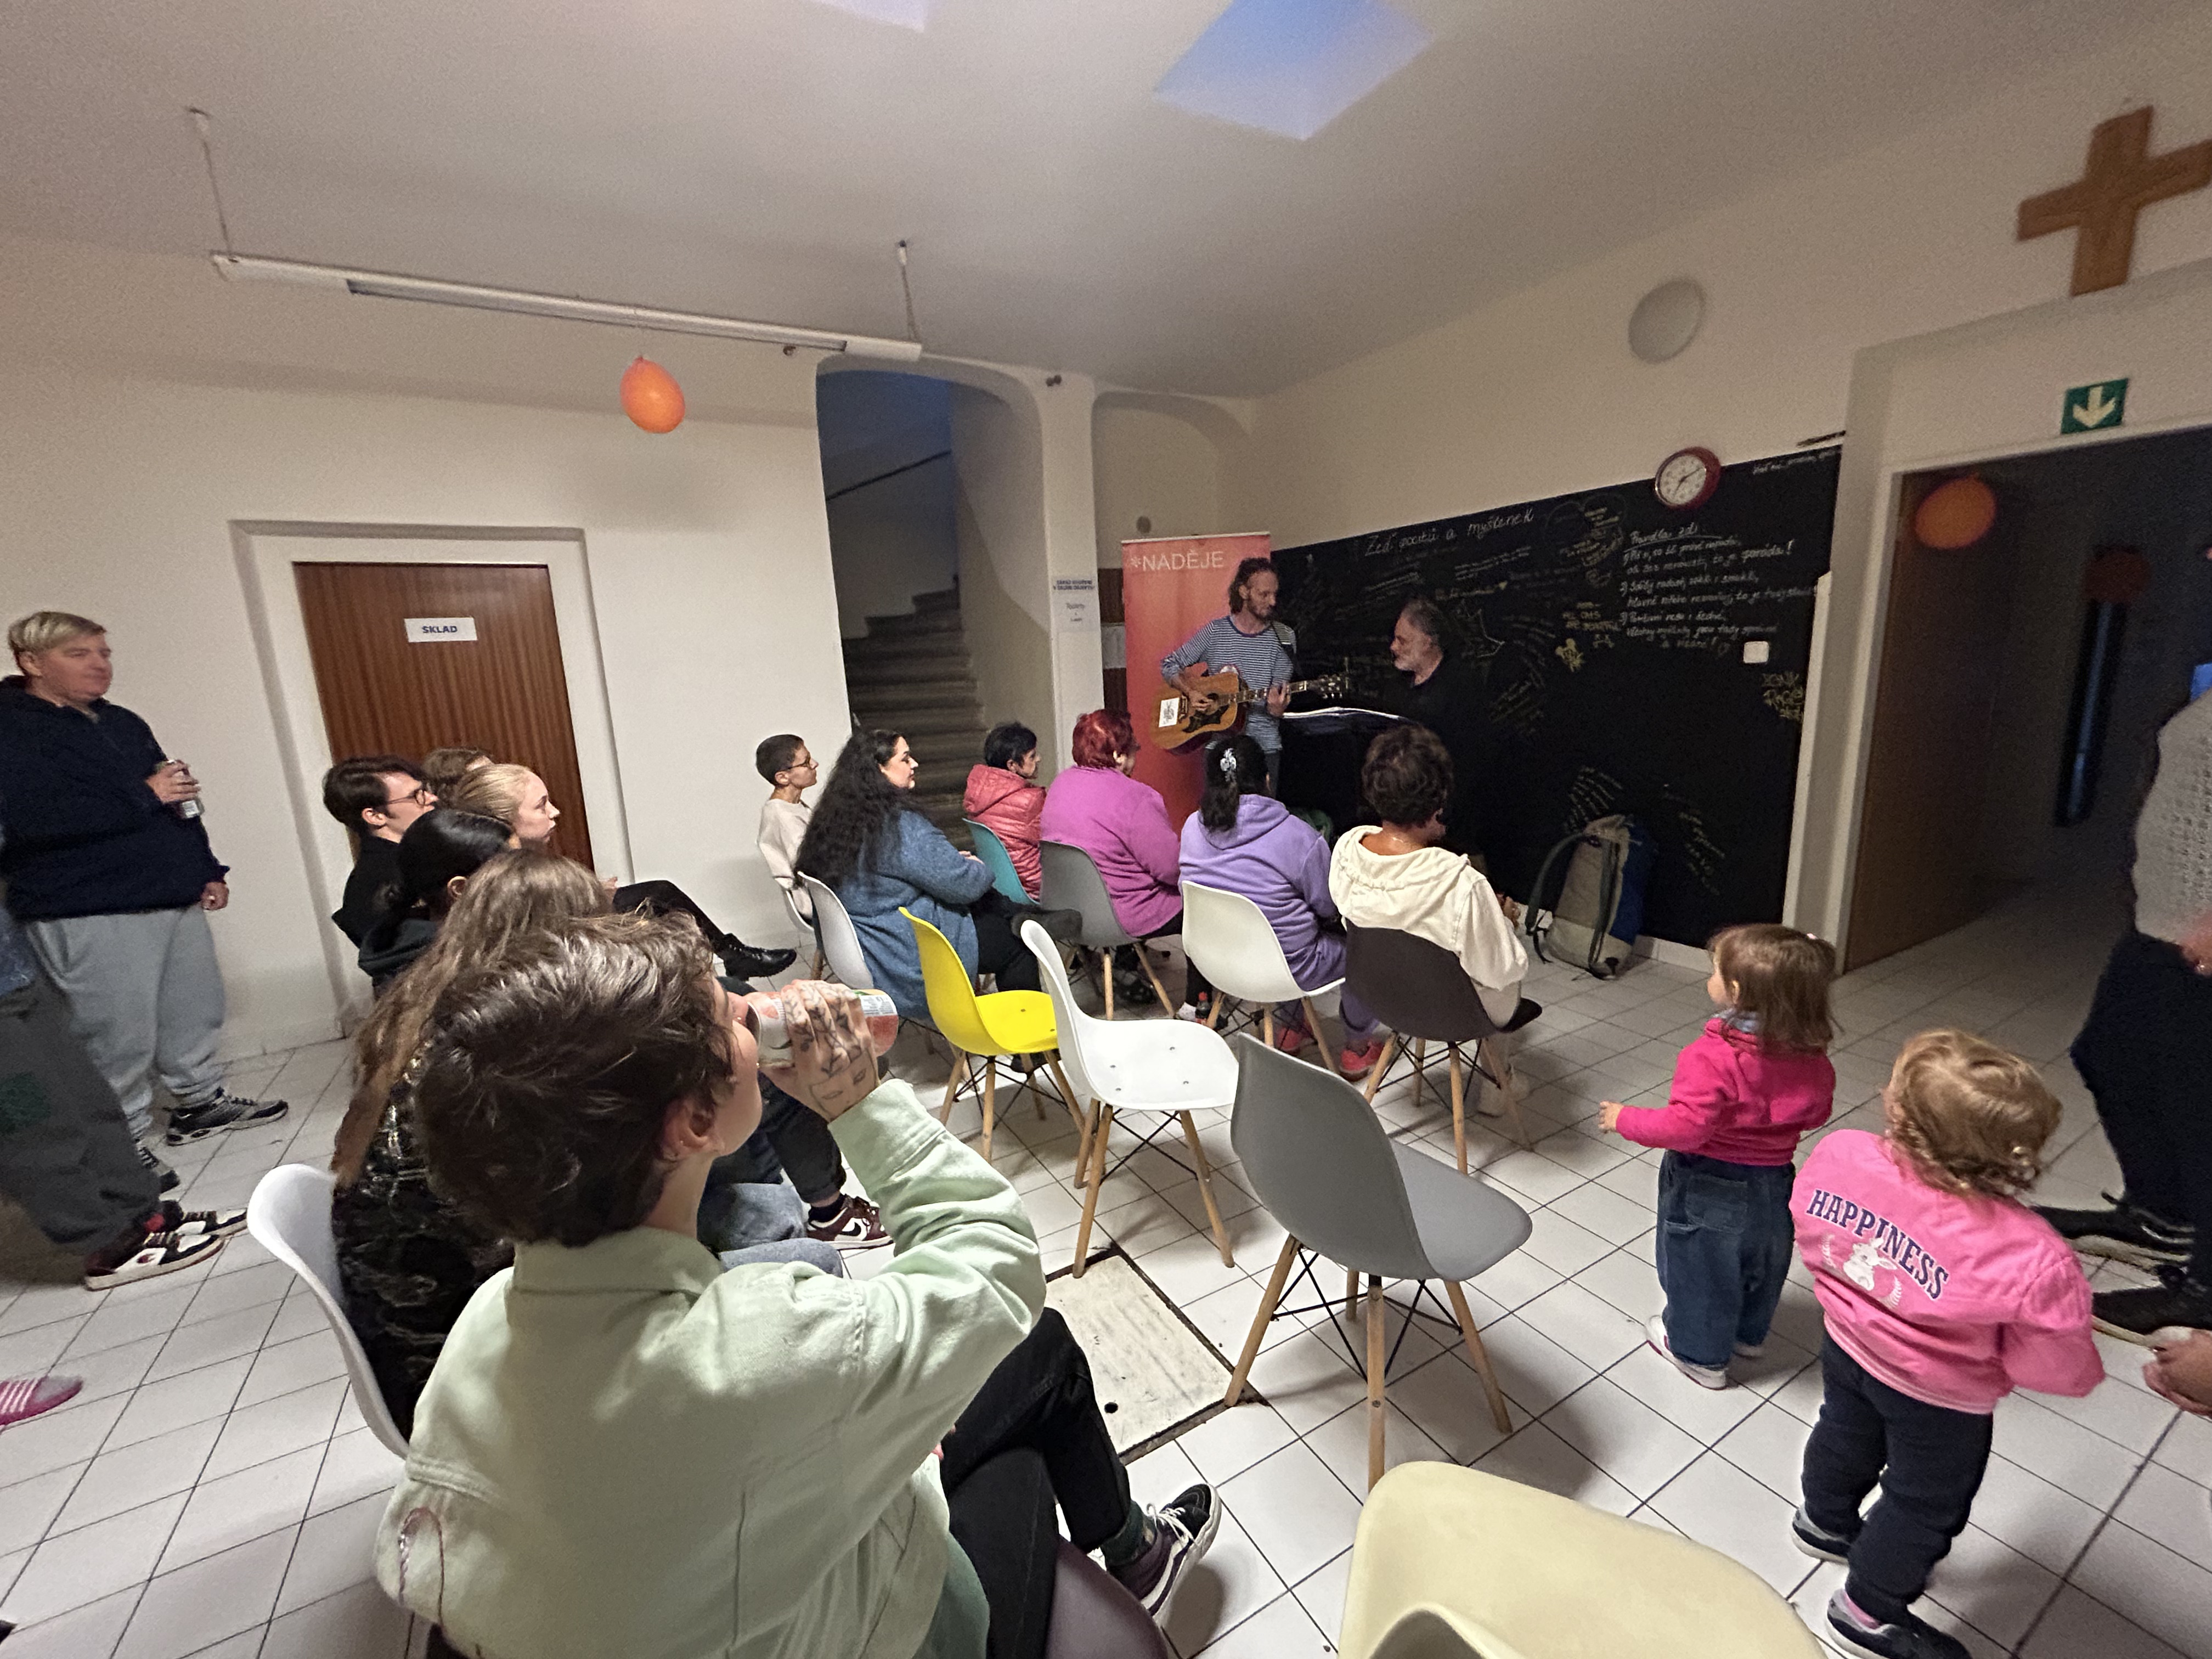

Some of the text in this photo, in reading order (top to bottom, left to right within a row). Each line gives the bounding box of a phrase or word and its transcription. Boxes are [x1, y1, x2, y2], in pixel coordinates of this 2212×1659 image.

[1446, 528, 1458, 541] a
[1142, 549, 1224, 571] NADĚJE
[1805, 1189, 1949, 1300] HAPPINESS
